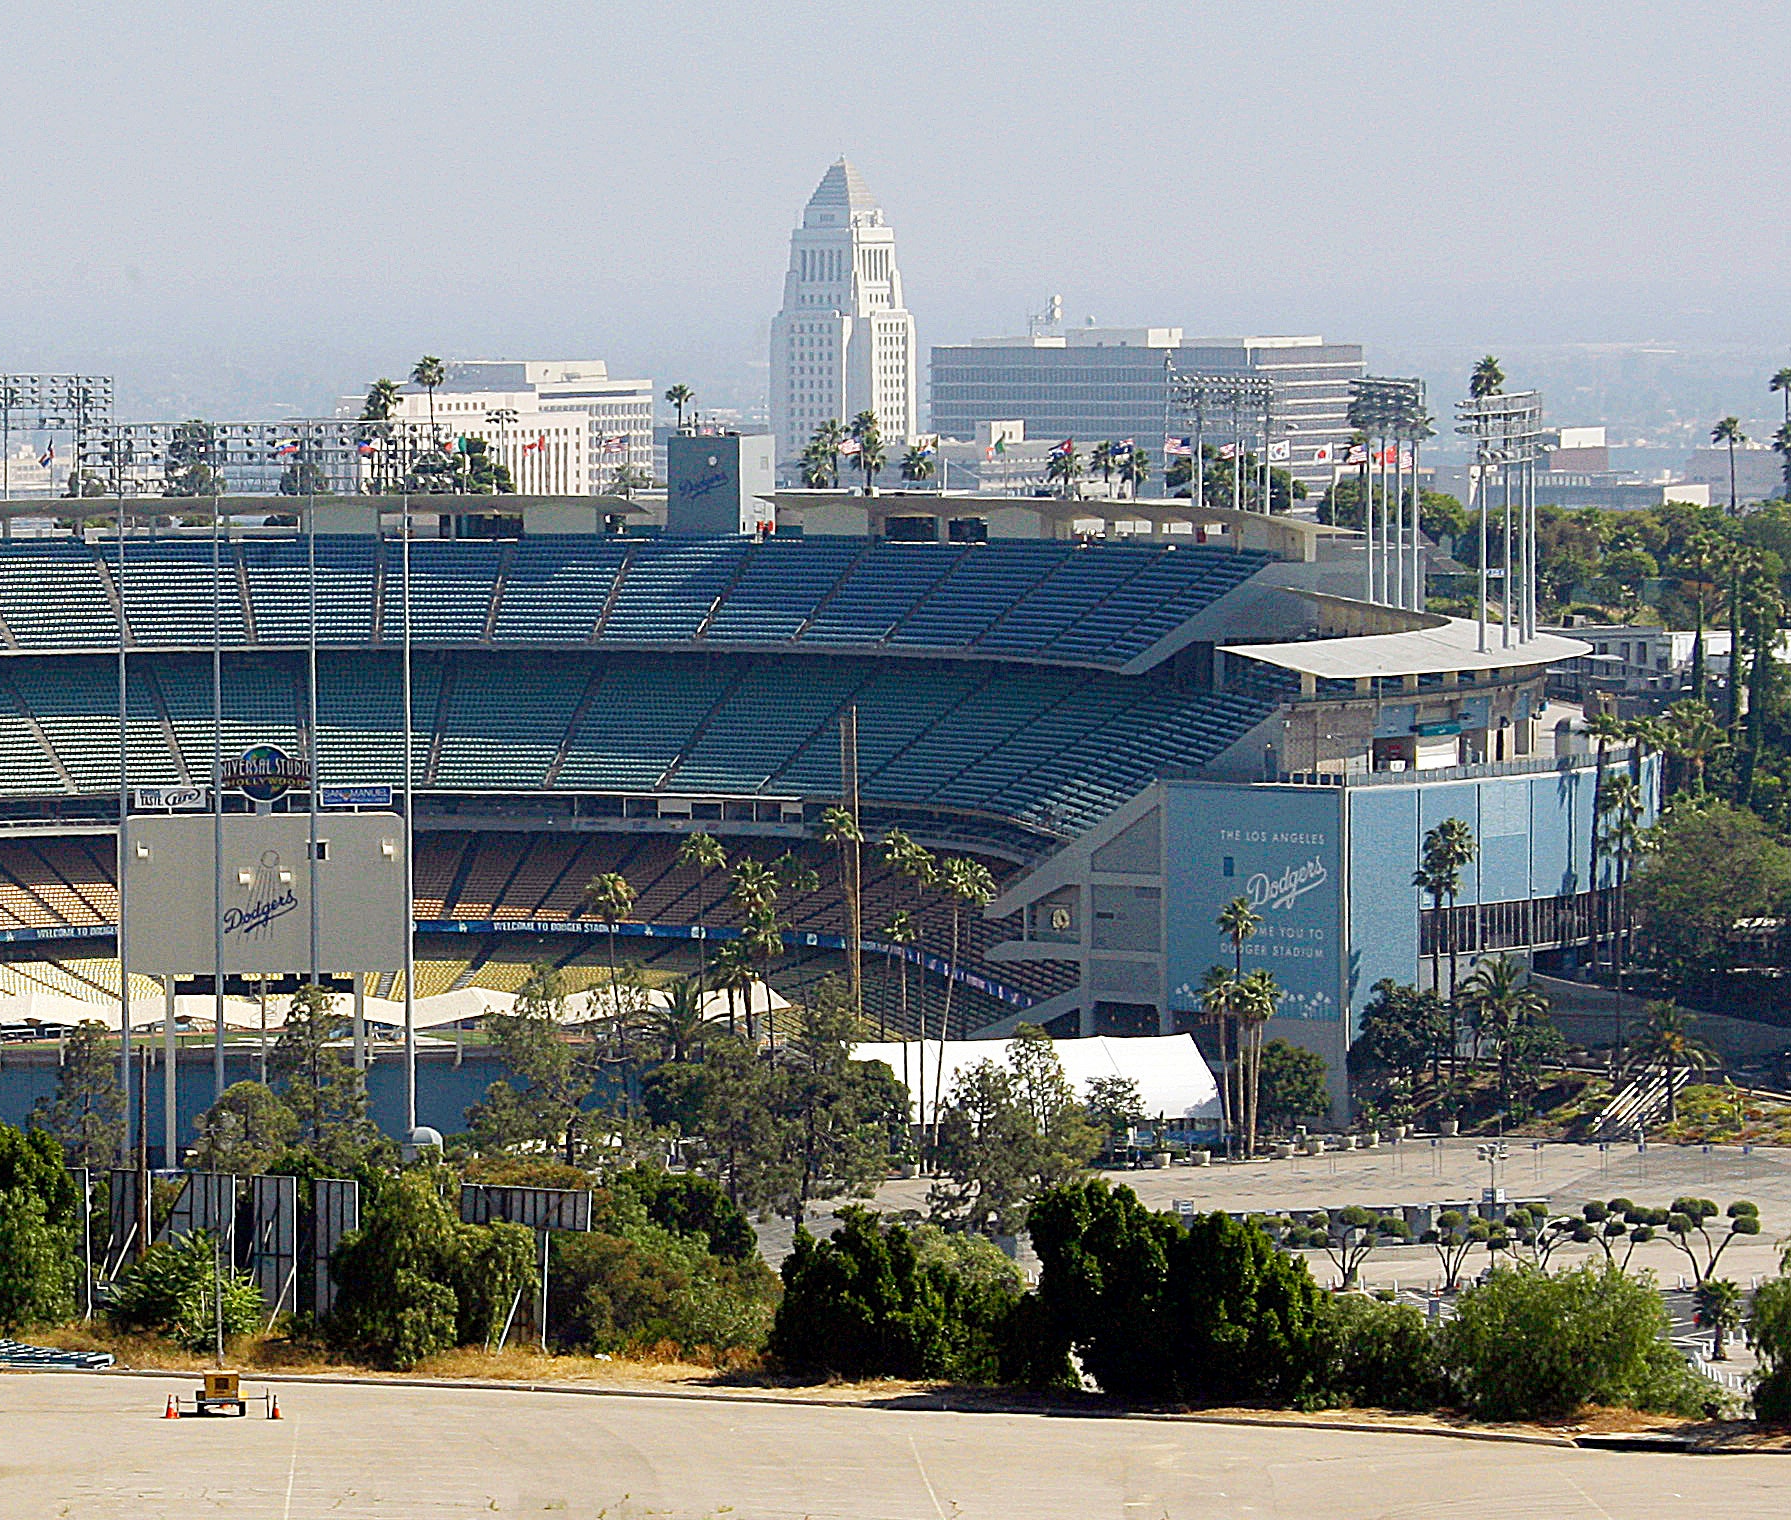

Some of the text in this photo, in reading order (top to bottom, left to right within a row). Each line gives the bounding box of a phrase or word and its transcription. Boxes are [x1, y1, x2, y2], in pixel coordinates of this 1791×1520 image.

[1221, 830, 1325, 845] THE LOS ANGELES
[1246, 855, 1327, 910] Dodgers
[224, 889, 298, 934] Dodgers
[493, 922, 535, 932] WELCOME
[538, 922, 548, 931] TO
[1280, 928, 1304, 939] YOU
[1310, 929, 1325, 940] TO
[1272, 945, 1324, 958] STADIUM
